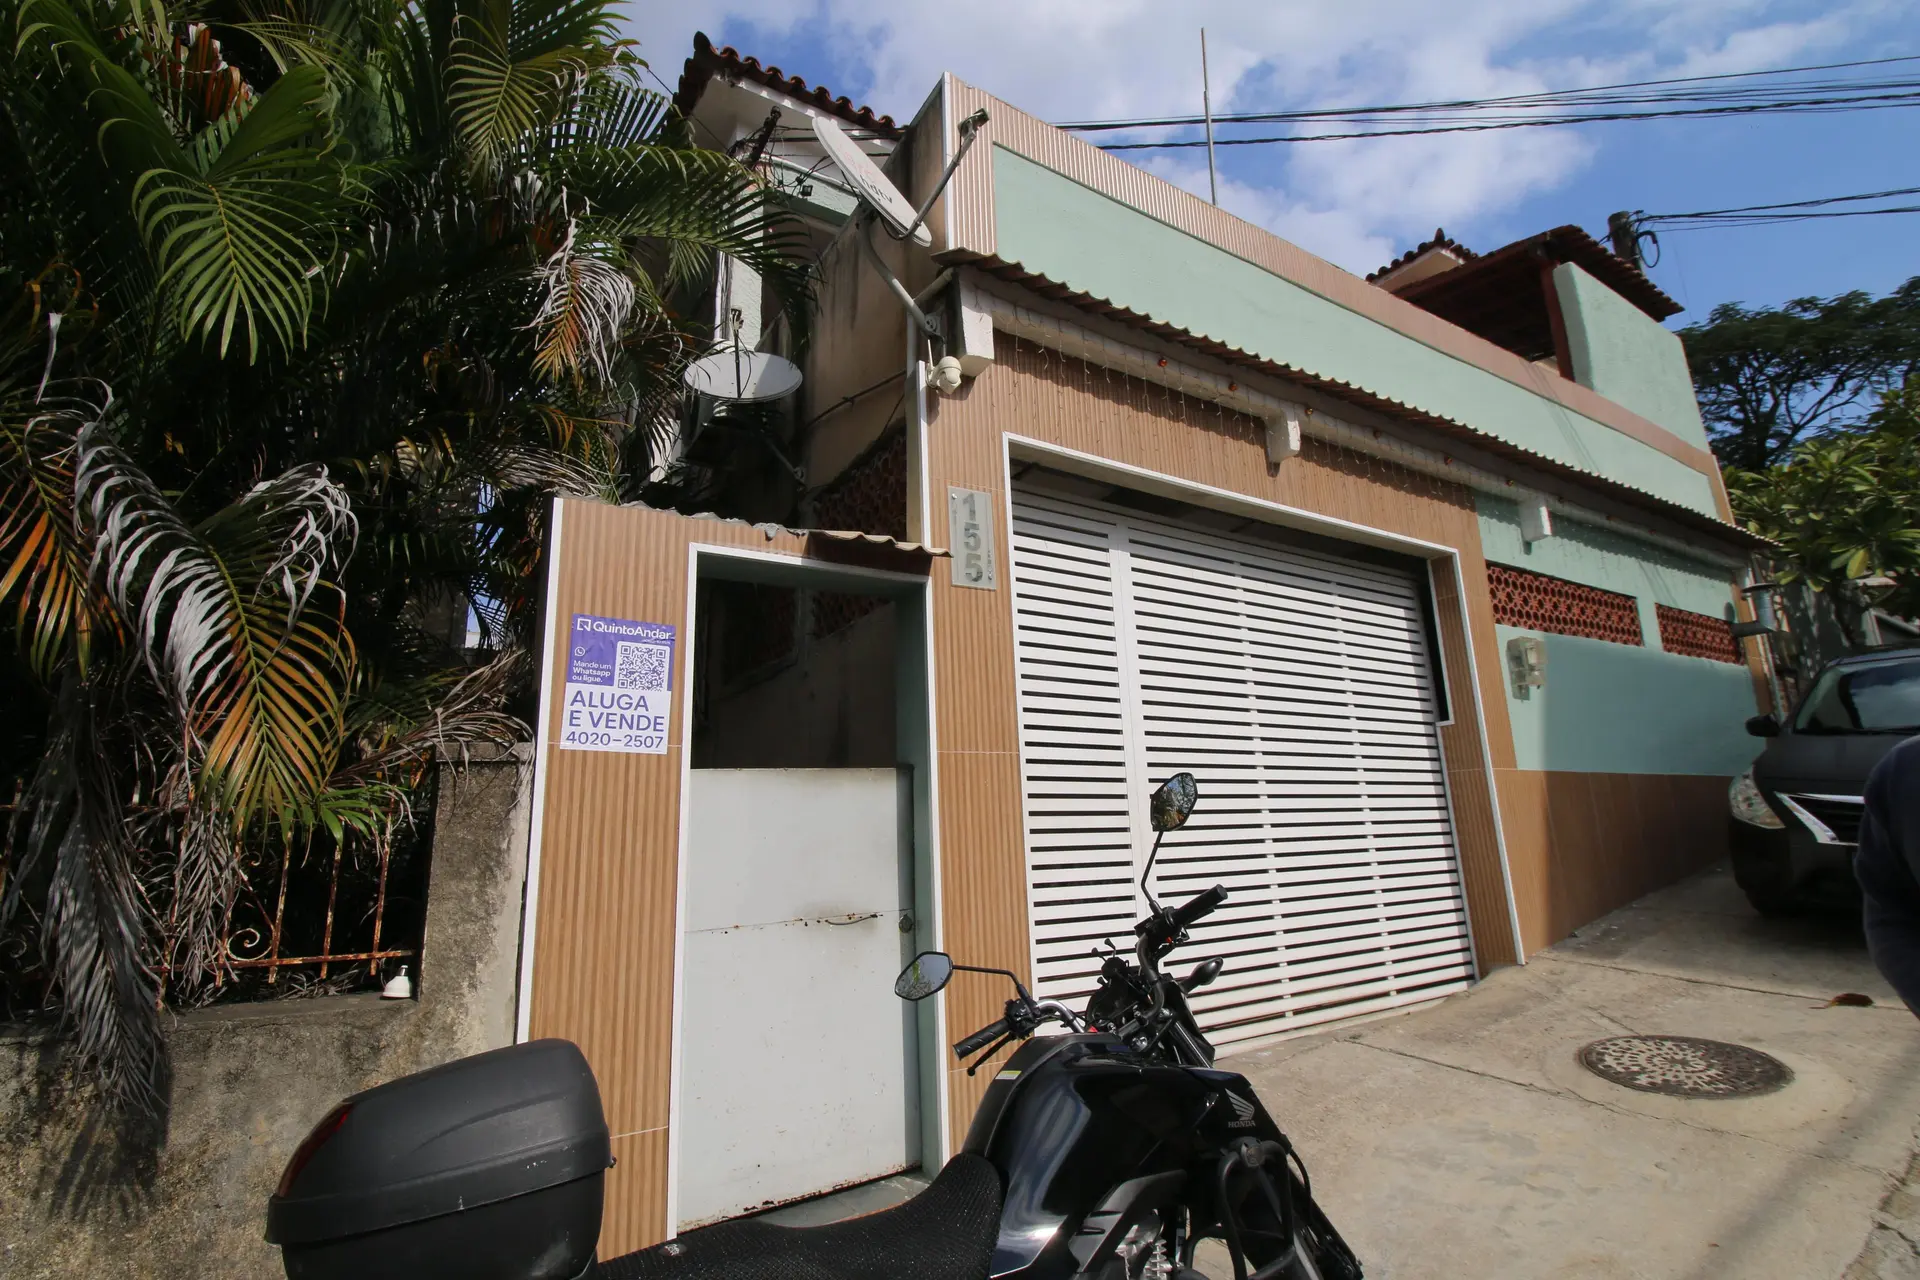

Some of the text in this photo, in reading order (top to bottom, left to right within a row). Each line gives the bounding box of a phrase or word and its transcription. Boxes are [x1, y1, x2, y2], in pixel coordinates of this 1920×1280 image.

[963, 492, 983, 582] 155
[593, 621, 672, 640] QuintoAndar
[573, 660, 599, 669] Mande
[573, 667, 611, 678] Whatsapp
[583, 675, 603, 683] ligue.
[570, 690, 649, 712] ALUGA
[568, 710, 665, 732] E VENDE
[566, 731, 664, 748] 4020-2507
[1228, 1120, 1256, 1128] HONDA
